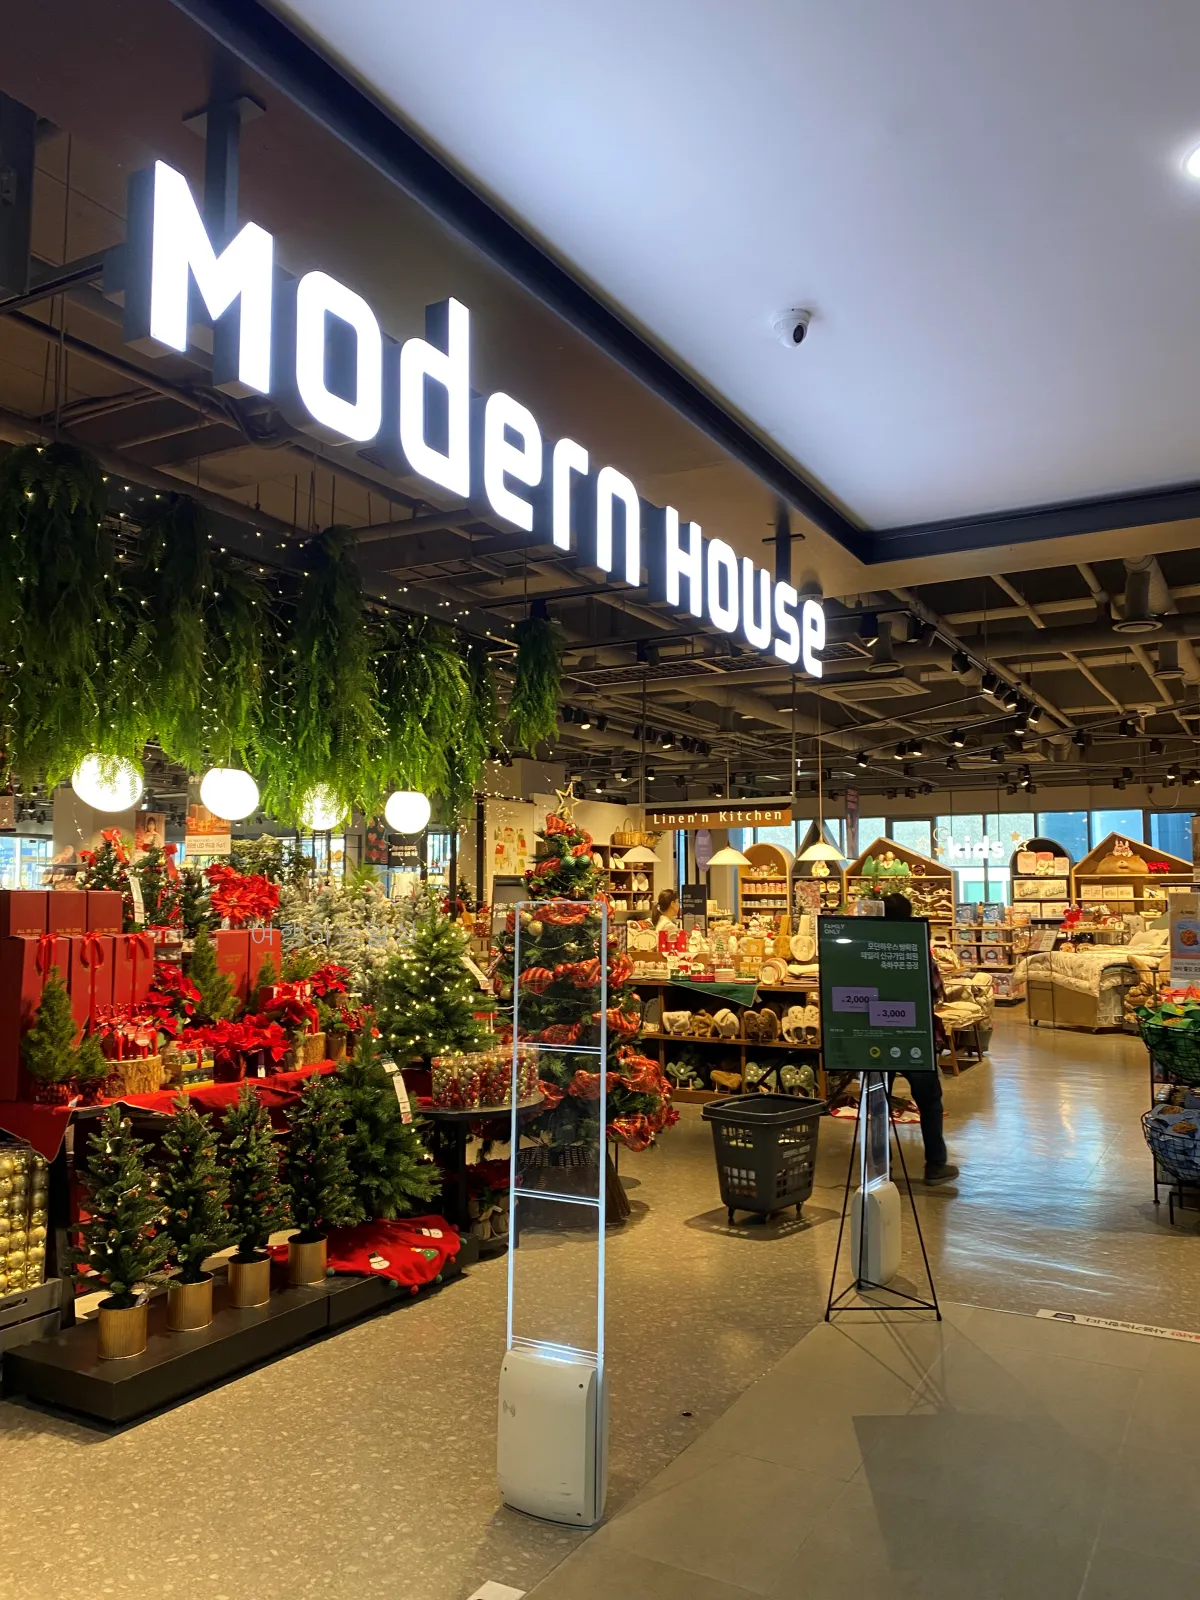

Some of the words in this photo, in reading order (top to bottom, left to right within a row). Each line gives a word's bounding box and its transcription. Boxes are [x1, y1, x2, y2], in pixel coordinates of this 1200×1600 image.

[149, 158, 641, 588] Modern
[653, 813, 709, 825] Linen'n
[719, 810, 782, 822] Kitchen
[947, 835, 1005, 859] kids
[868, 942, 898, 951] 모던하우스
[880, 952, 905, 961] 신규가입
[905, 952, 919, 961] 회원
[906, 961, 919, 970] 증정
[845, 995, 870, 1004] 2,000
[882, 1009, 906, 1018] 3,000
